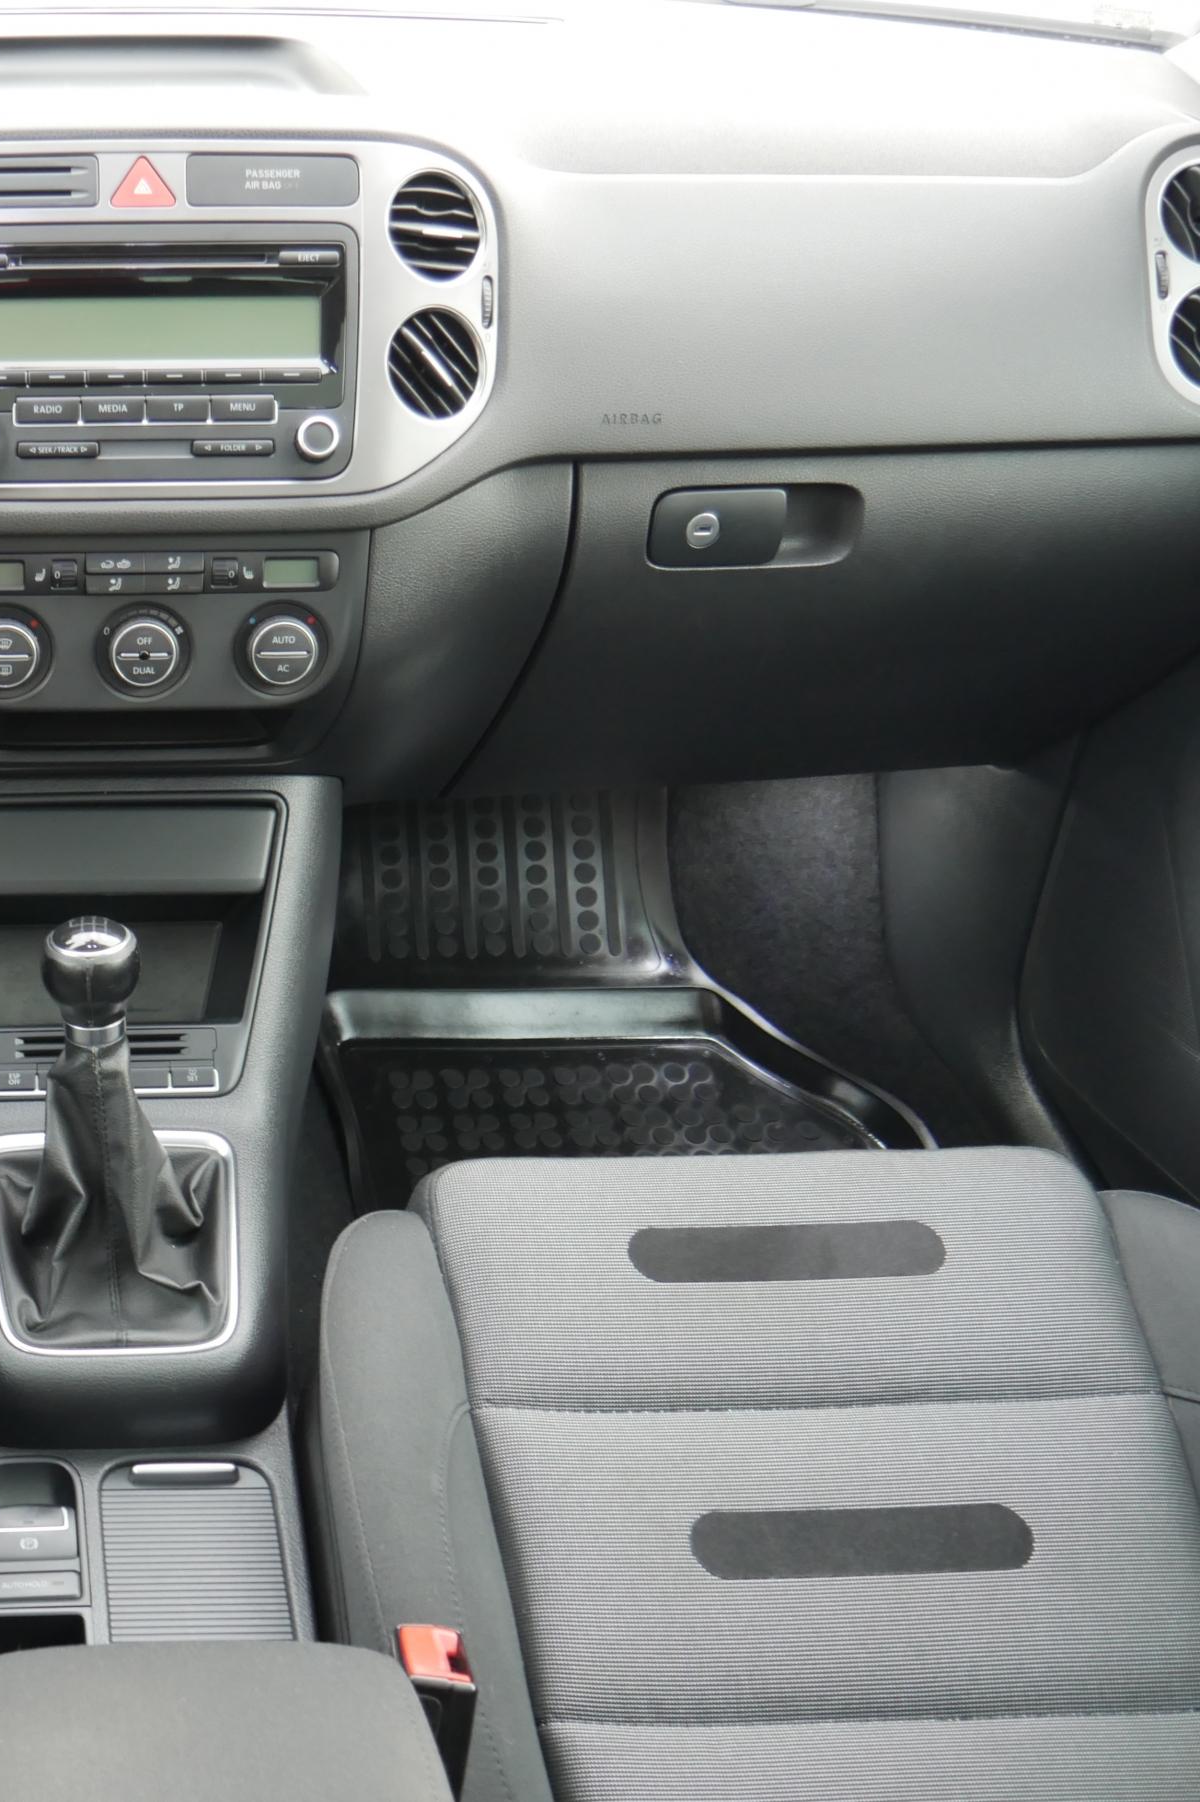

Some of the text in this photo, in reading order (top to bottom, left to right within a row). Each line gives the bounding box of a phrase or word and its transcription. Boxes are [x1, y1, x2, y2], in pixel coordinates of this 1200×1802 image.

[245, 168, 300, 178] PASSENGER
[244, 181, 260, 190] AIR
[262, 181, 281, 190] BAG
[297, 254, 319, 263] EJECT
[33, 404, 62, 414] RADIO
[98, 404, 128, 413] MEDIA
[173, 403, 184, 411] TP
[230, 402, 256, 412] MENU
[601, 413, 663, 425] AIRBAG
[220, 444, 246, 452] FOLDER
[136, 637, 152, 645] OFF
[272, 636, 296, 644] AUTO
[132, 666, 155, 675] DUAL
[277, 664, 290, 672] AC
